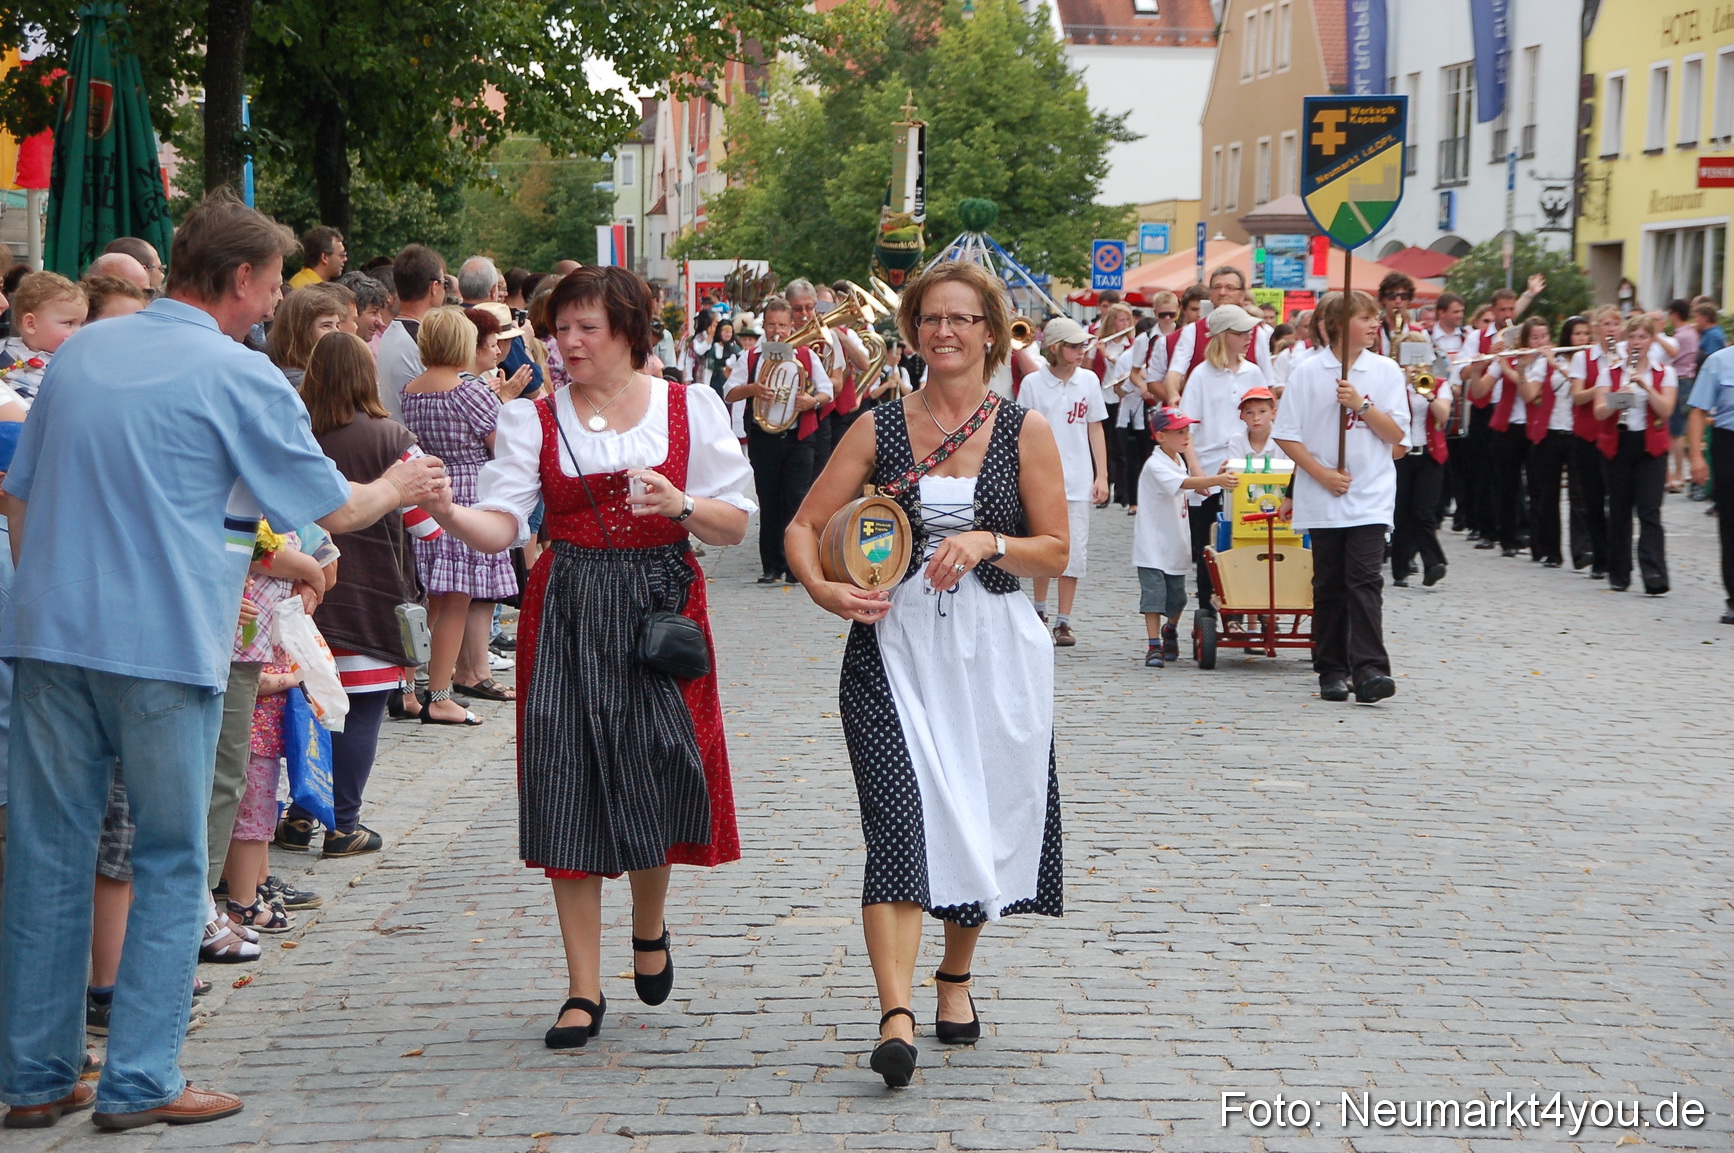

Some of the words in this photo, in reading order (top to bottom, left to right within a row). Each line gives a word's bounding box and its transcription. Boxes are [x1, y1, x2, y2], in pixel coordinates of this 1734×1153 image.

[1660, 9, 1701, 50] HOTEL
[1350, 105, 1397, 116] Werkvolk
[1349, 115, 1388, 125] Kapelle
[1315, 154, 1361, 184] Neumarkt
[1095, 274, 1122, 288] TAXI
